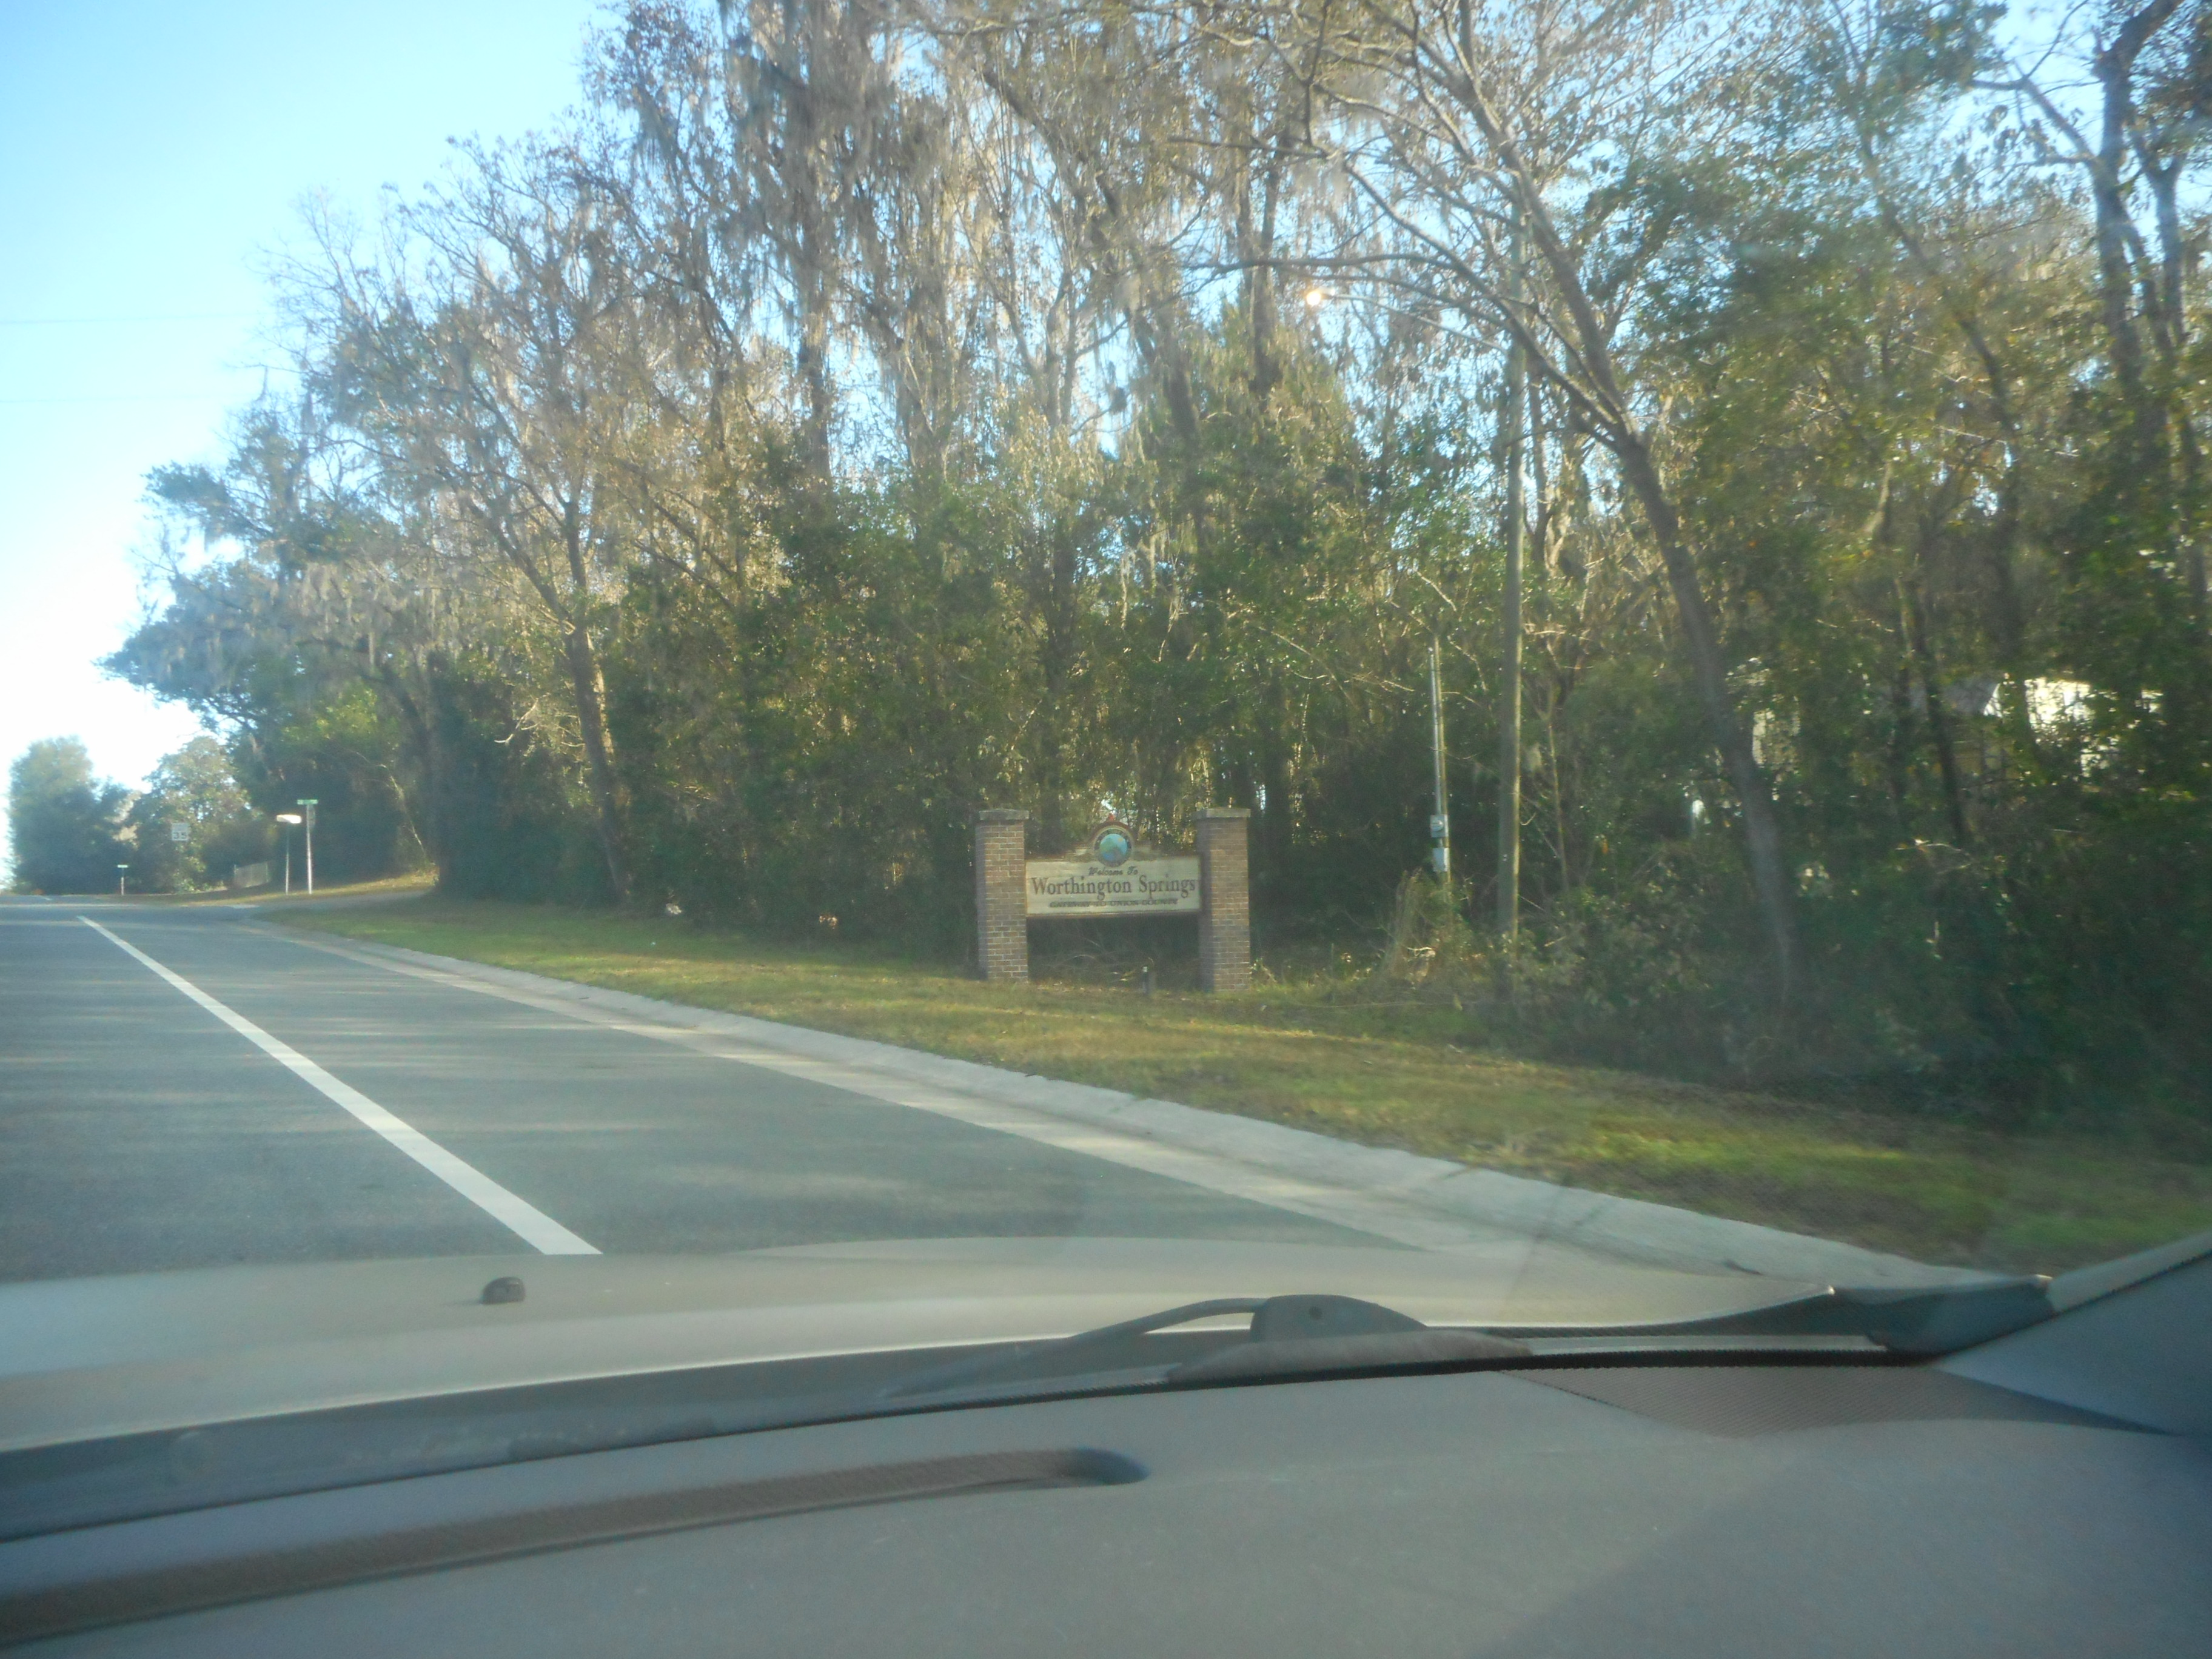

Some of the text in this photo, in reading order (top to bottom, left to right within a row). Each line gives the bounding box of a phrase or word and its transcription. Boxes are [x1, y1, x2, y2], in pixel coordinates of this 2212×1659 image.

[1088, 866, 1123, 876] Welcome
[1031, 874, 1196, 900] Worthington Springs
